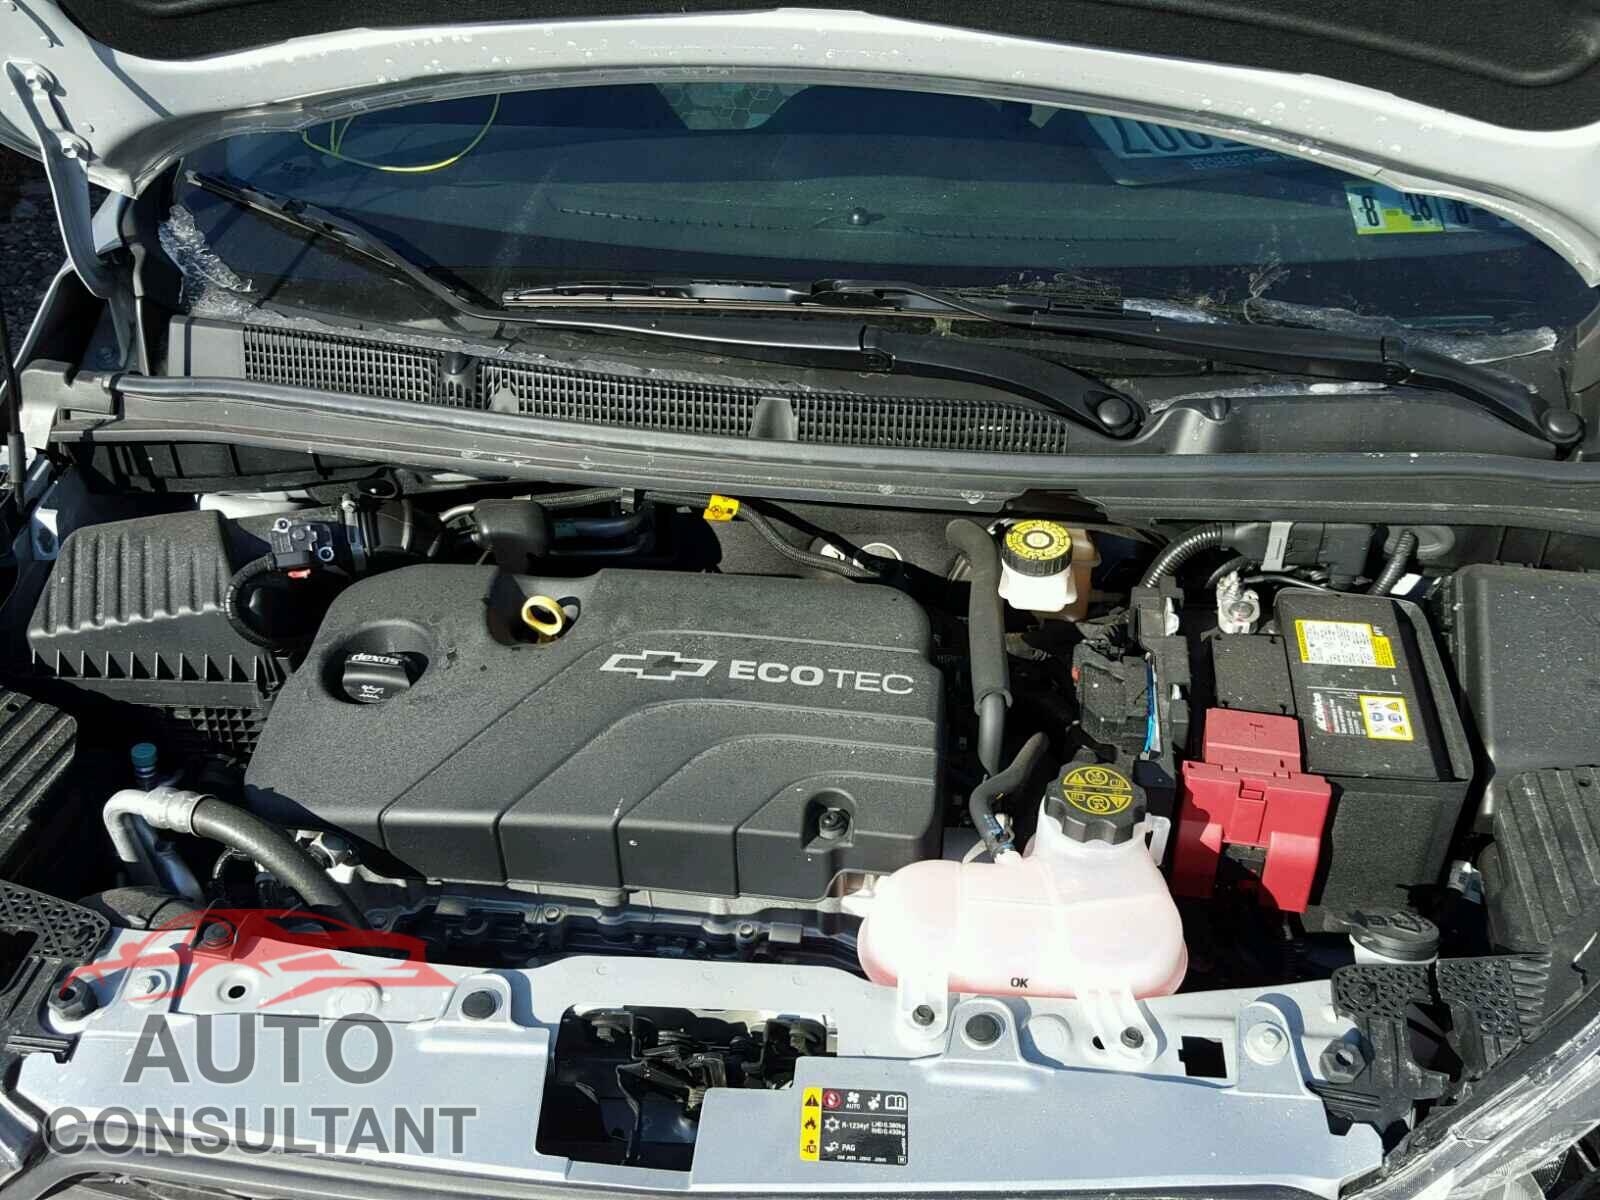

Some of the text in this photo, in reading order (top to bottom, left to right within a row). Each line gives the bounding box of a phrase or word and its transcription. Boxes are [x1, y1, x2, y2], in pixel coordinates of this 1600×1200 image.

[351, 652, 400, 665] dexos
[729, 659, 914, 695] ECOTEC
[1010, 977, 1029, 988] OK
